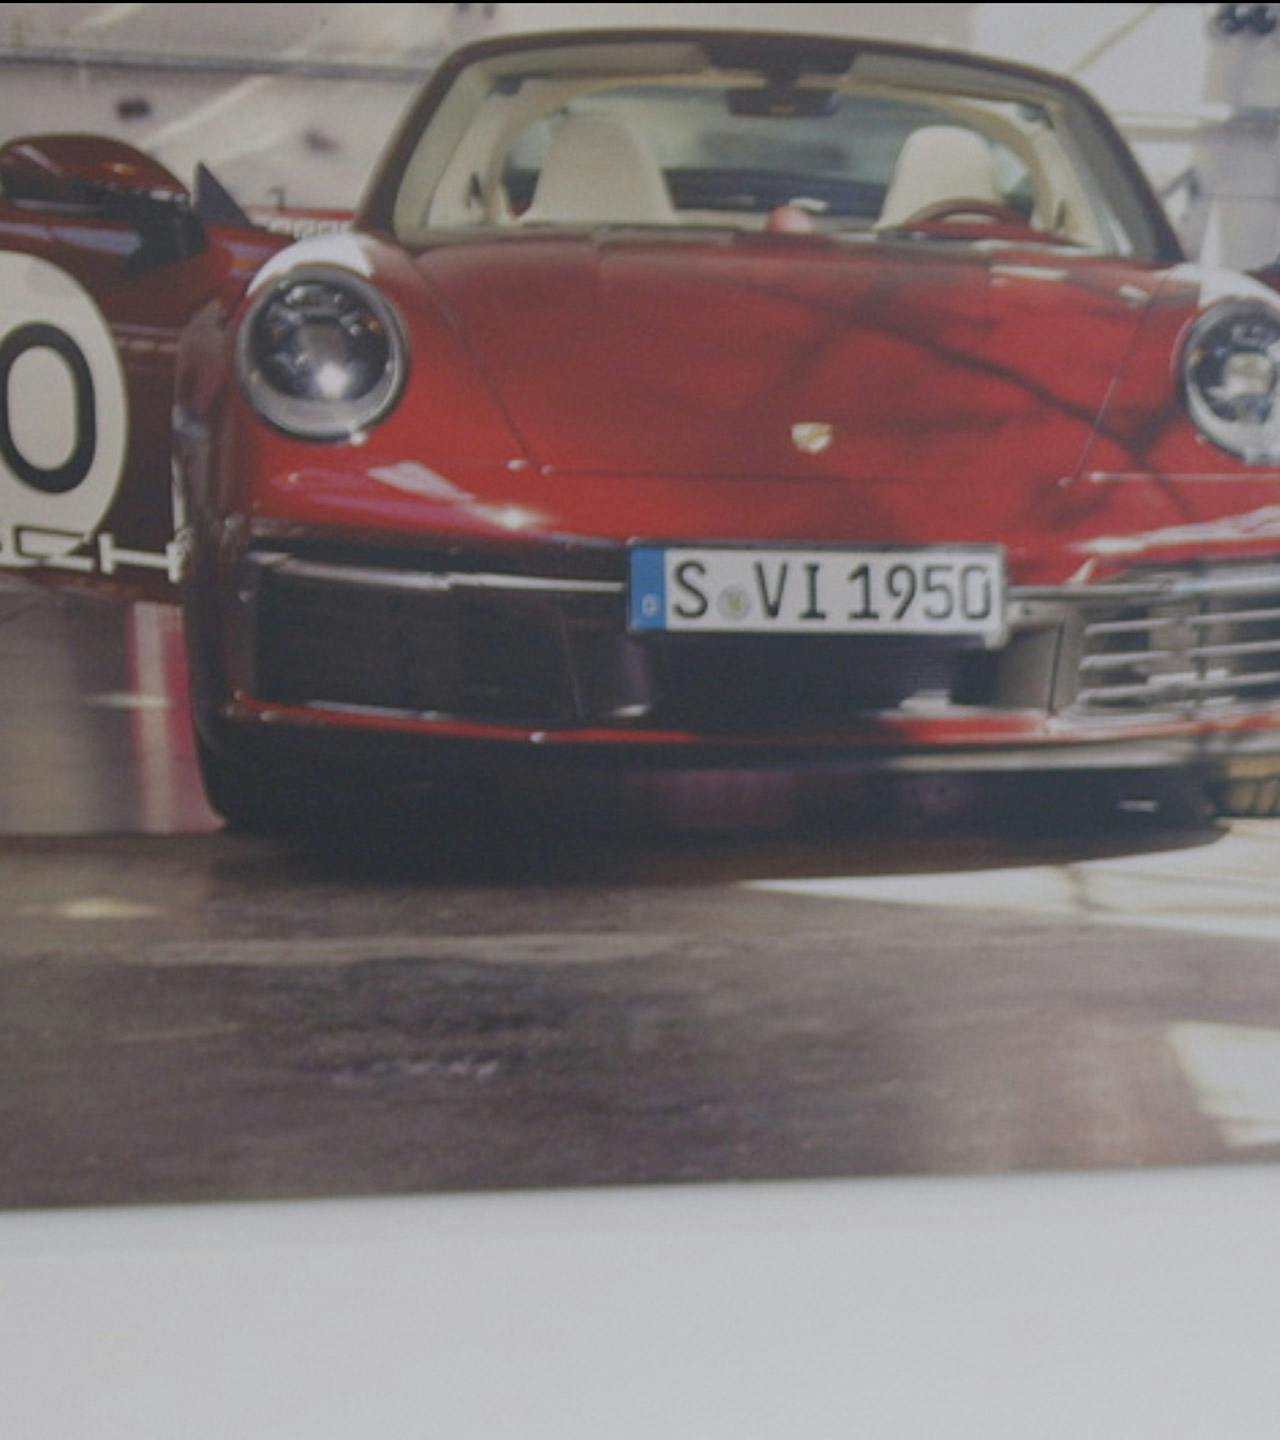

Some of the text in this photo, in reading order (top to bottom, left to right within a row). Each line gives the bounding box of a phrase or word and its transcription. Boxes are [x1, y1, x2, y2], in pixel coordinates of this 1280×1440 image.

[673, 559, 992, 621] S VI 1950
